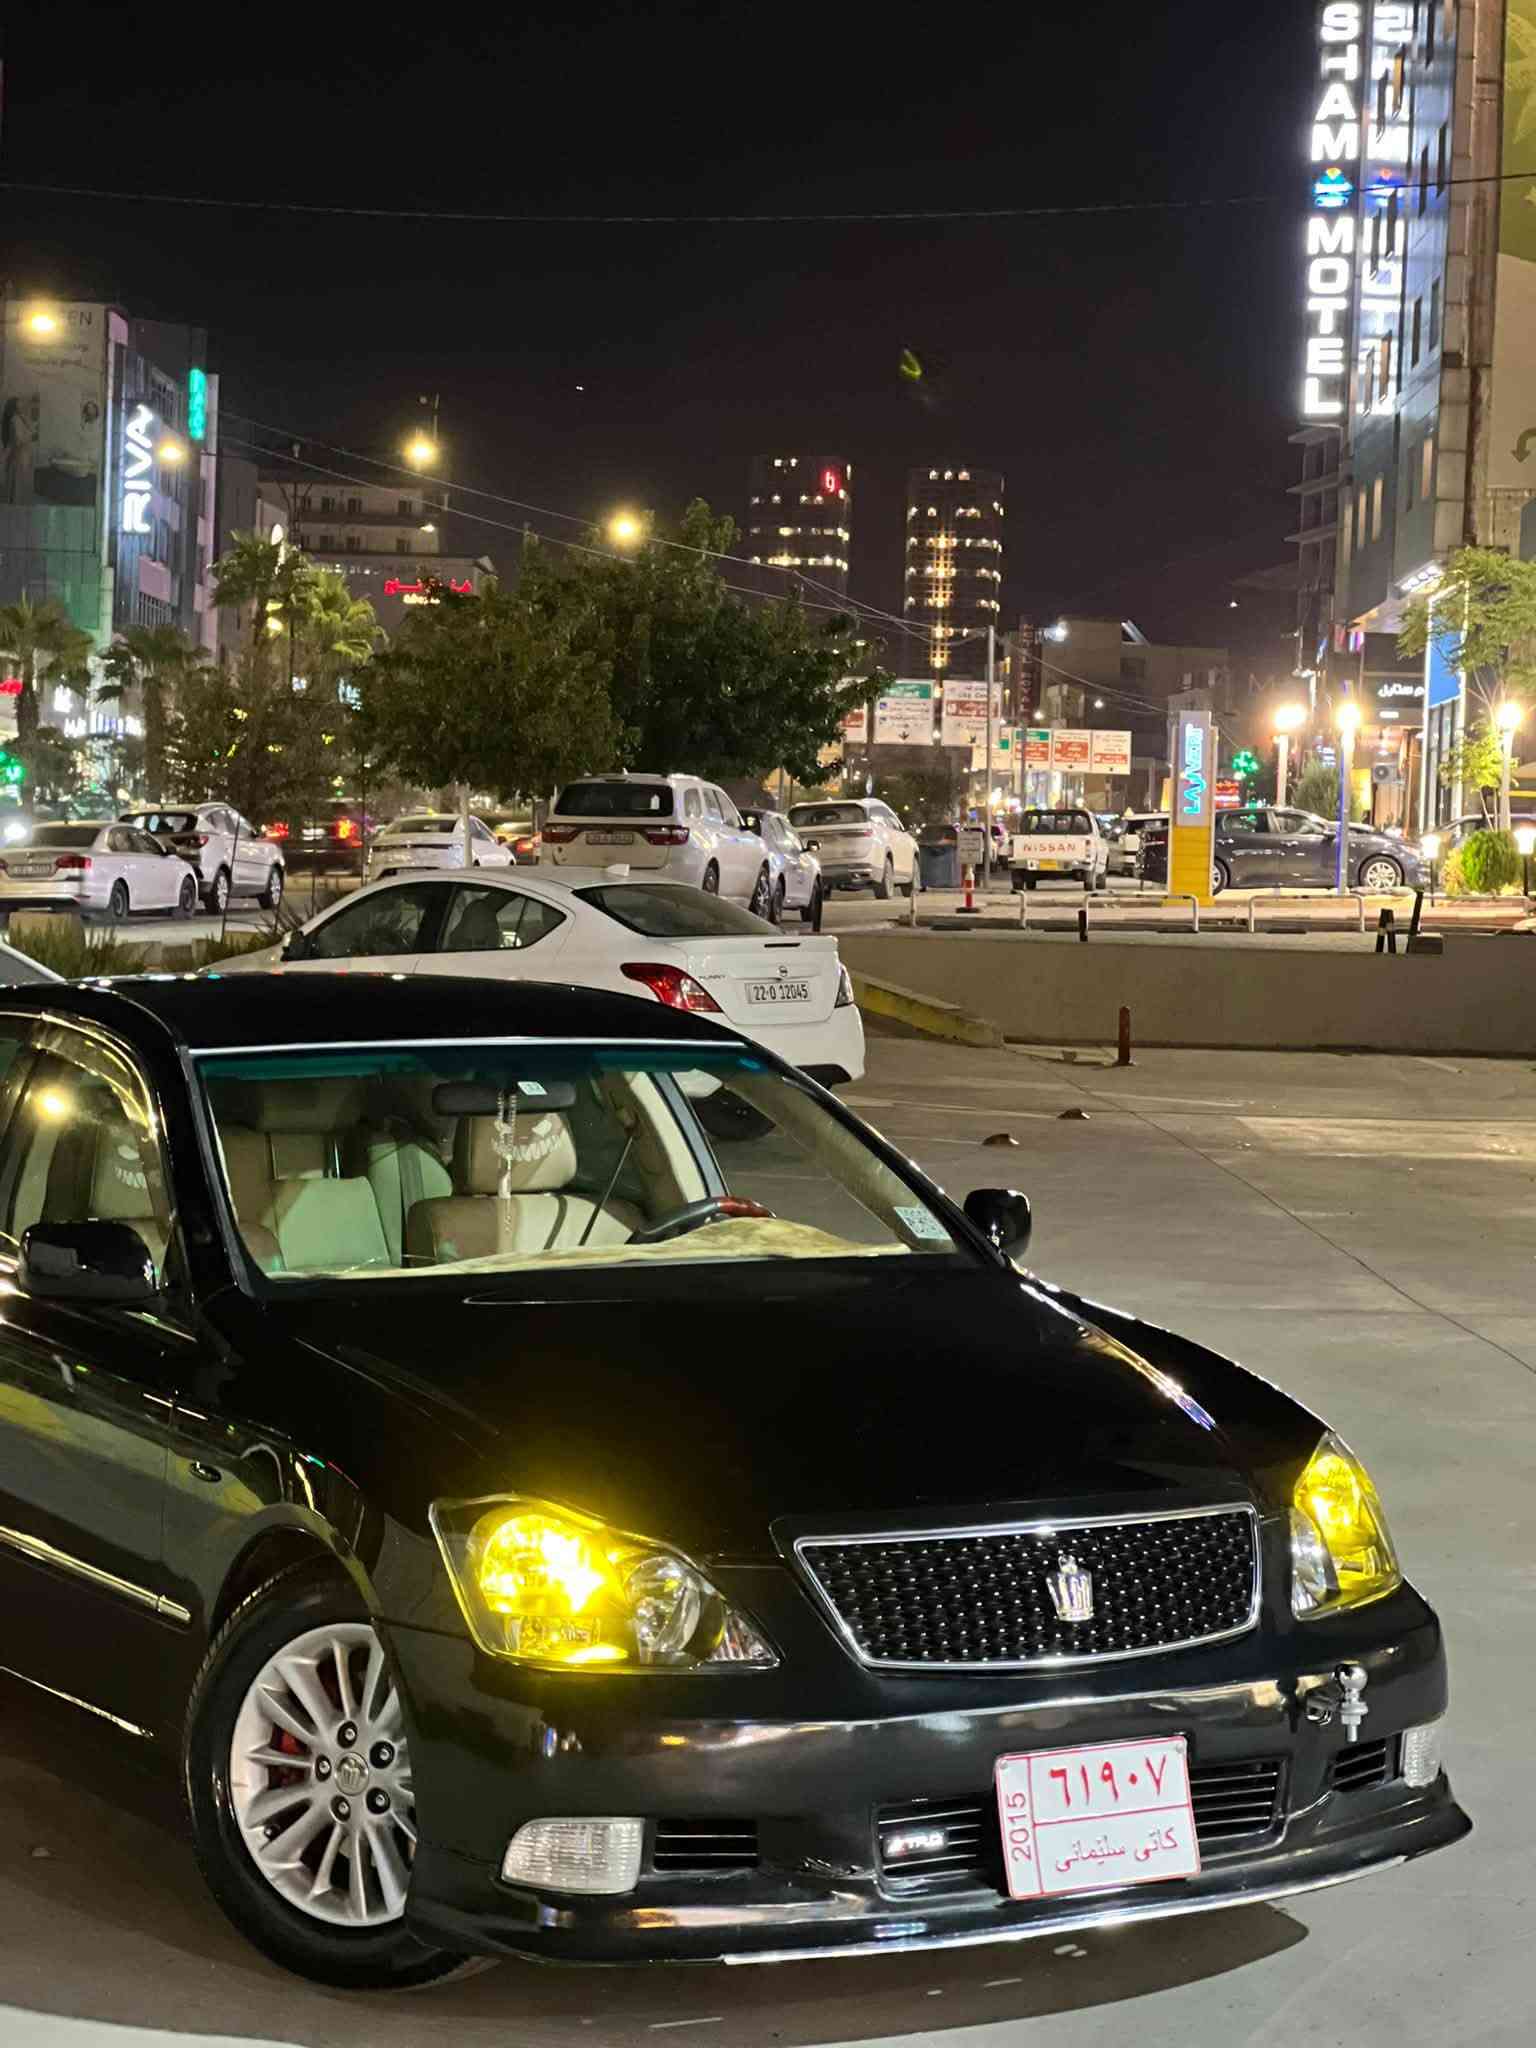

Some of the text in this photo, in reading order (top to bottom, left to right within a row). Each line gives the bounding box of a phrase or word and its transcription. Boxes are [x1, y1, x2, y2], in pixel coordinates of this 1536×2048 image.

[1304, 3, 1360, 415] SHAM MOTEL
[123, 404, 153, 533] RIVA
[1023, 842, 1076, 853] NISSAN
[779, 983, 809, 1000] 12045
[1050, 1755, 1167, 1807] ٦١٩٠٧
[1007, 1792, 1032, 1863] 2015
